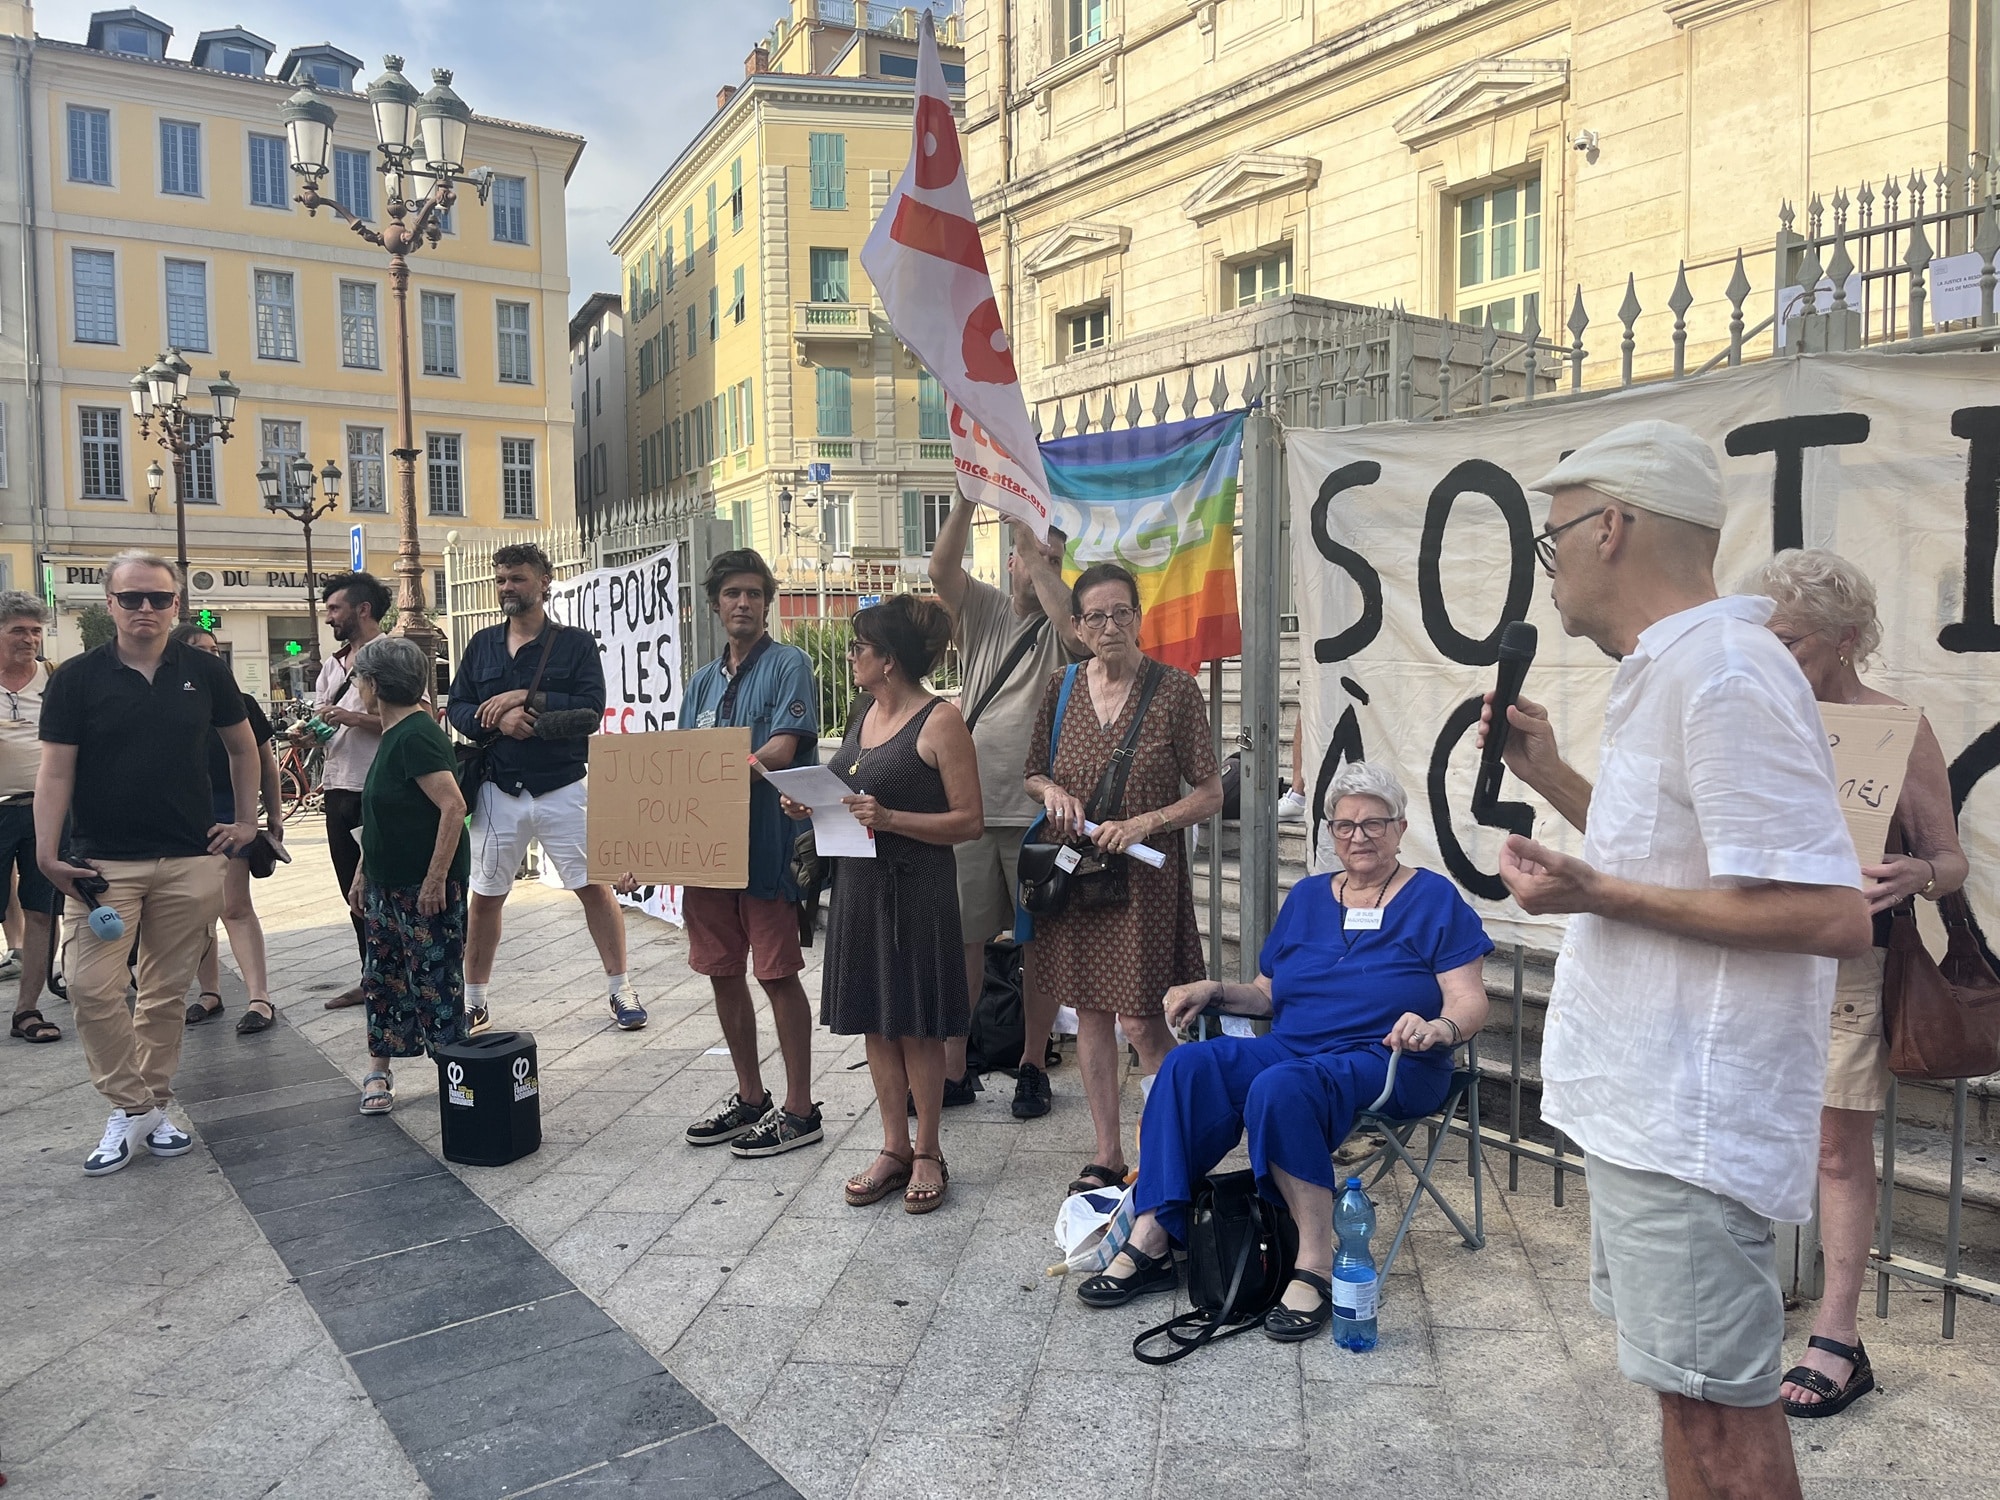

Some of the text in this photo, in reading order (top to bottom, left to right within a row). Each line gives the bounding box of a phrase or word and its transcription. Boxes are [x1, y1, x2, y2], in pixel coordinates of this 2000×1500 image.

[353, 535, 360, 564] P
[223, 570, 249, 587] DU
[610, 557, 673, 637] POUR
[621, 634, 671, 703] LES
[604, 749, 738, 786] JUSTICE
[637, 797, 708, 828] POUR
[598, 833, 728, 868] GENEVIÈVE
